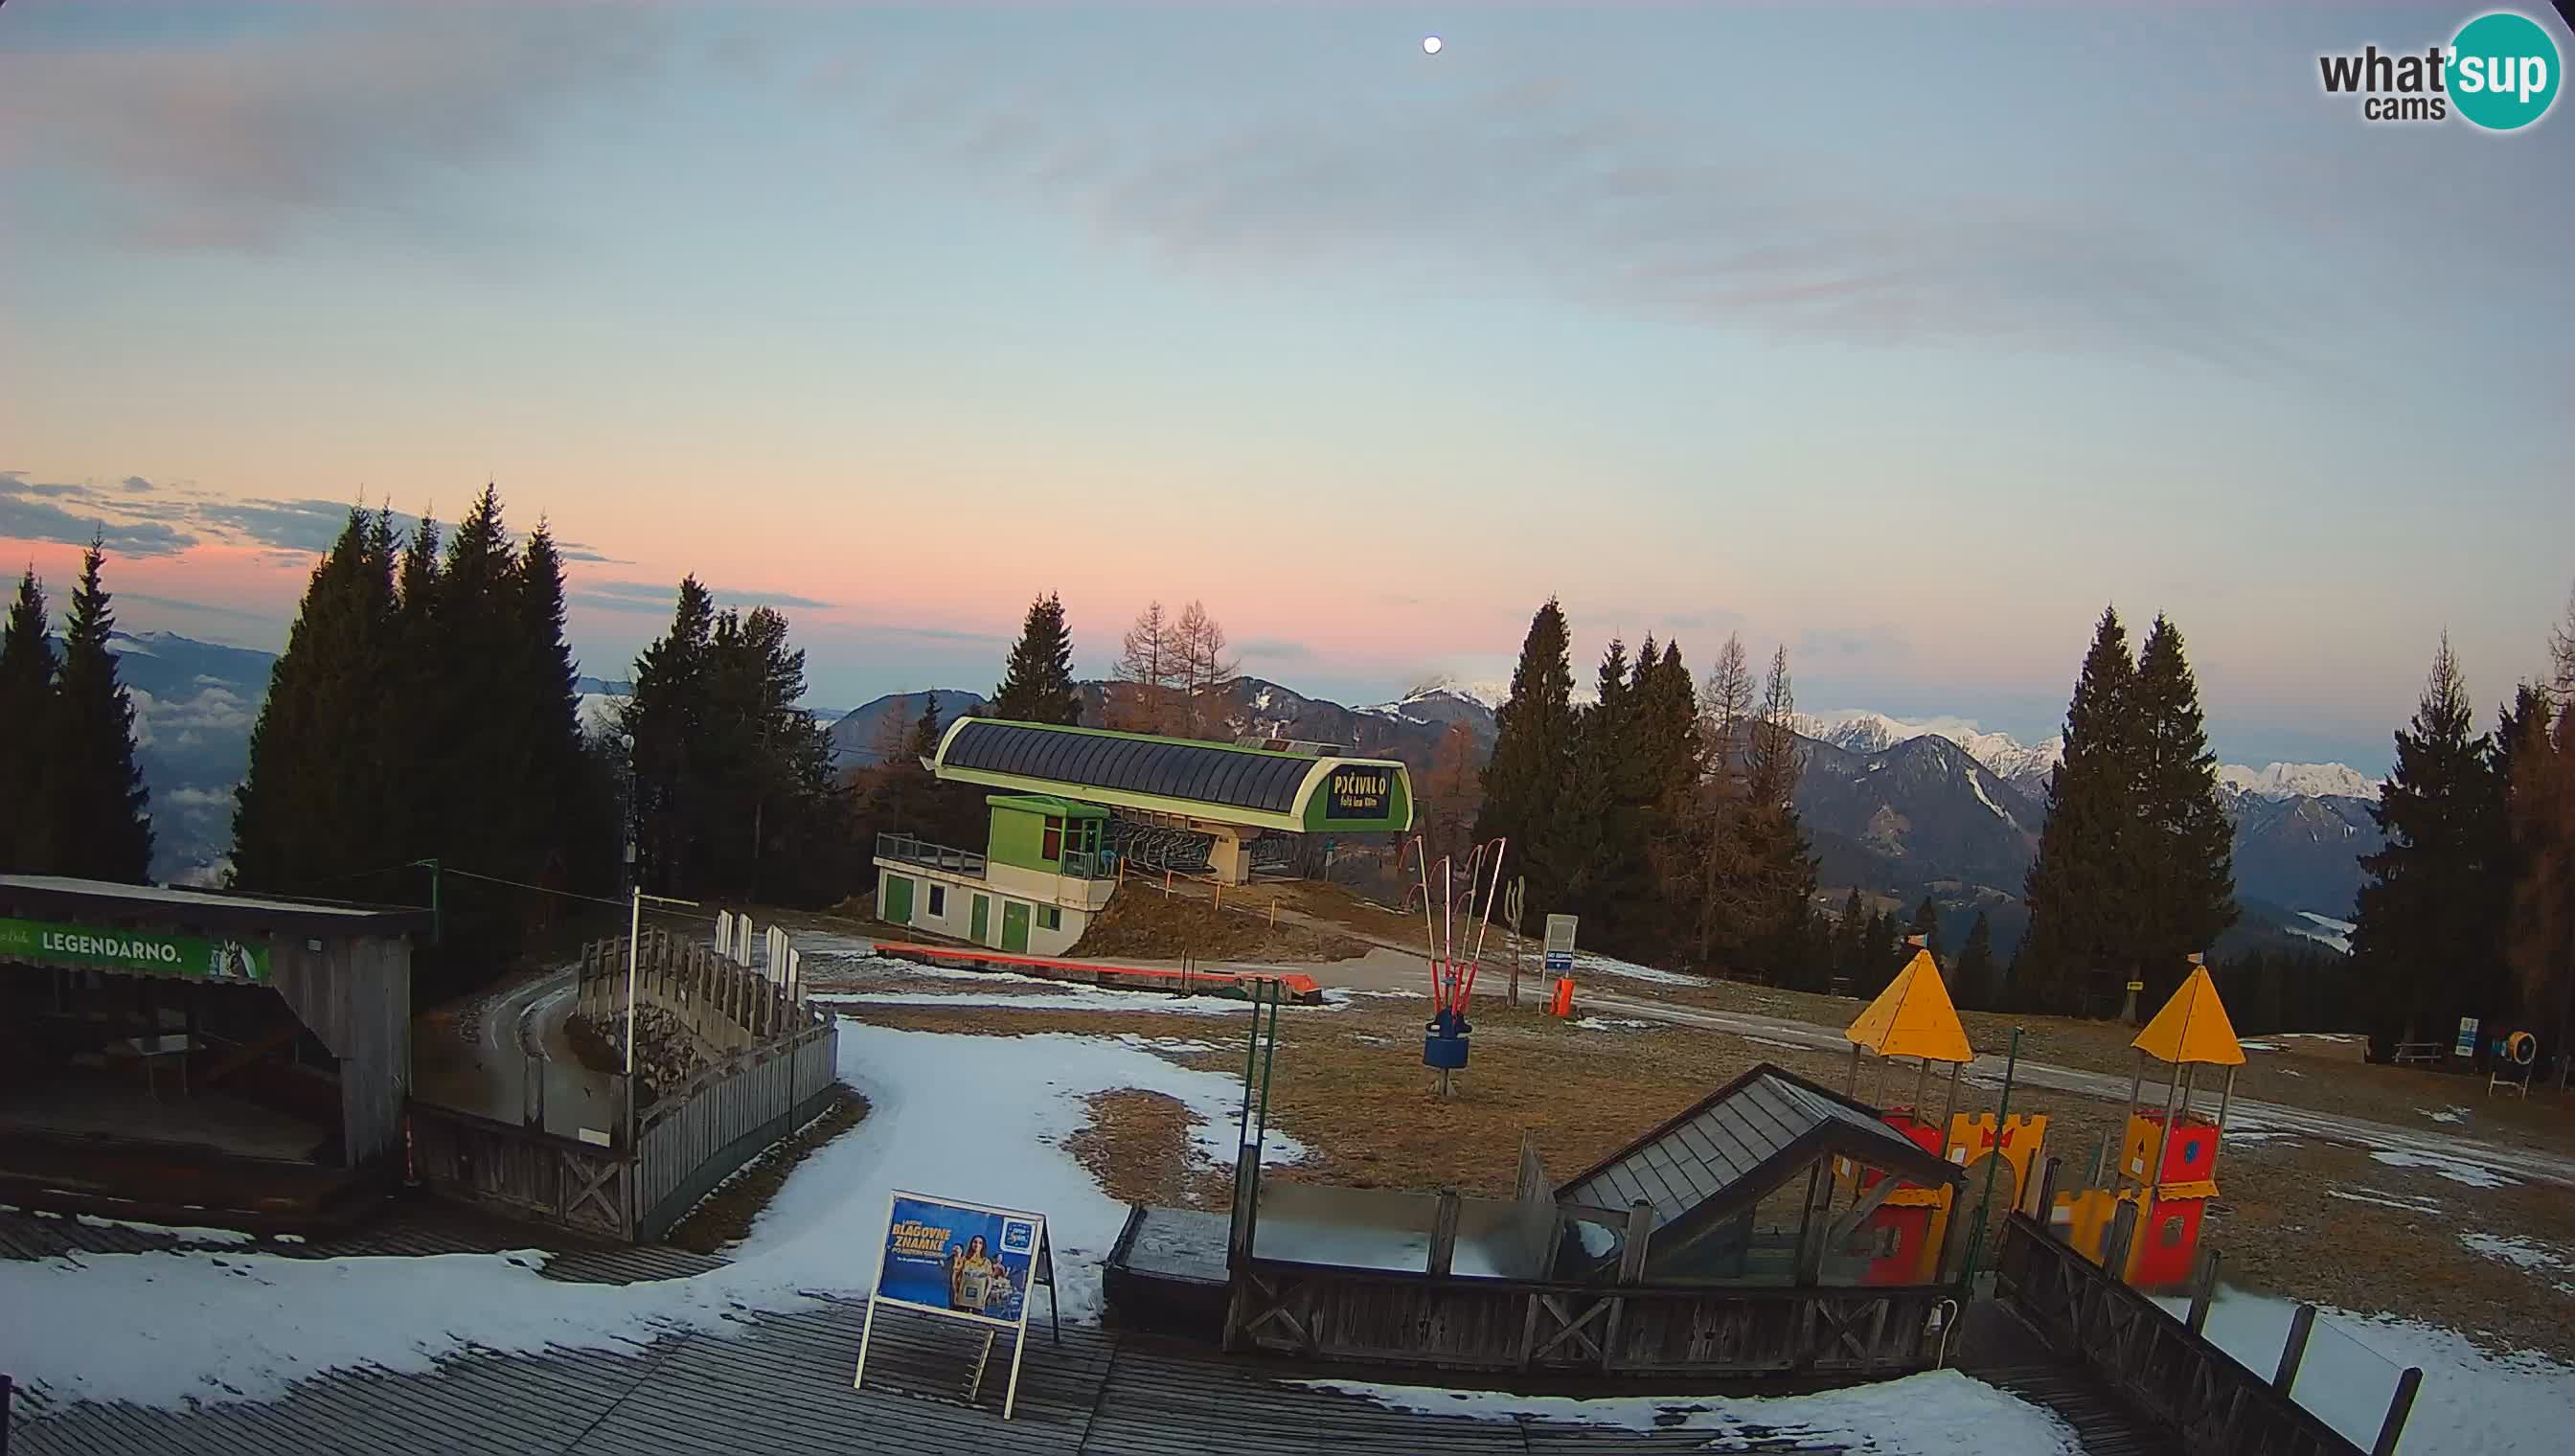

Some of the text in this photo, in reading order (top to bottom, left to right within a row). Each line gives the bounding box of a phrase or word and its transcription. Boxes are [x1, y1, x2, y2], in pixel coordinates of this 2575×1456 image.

[43, 931, 182, 963] LEGENDARNO.
[892, 1223, 951, 1241] BLAGOVNE
[894, 1236, 946, 1251] ZNAMKE
